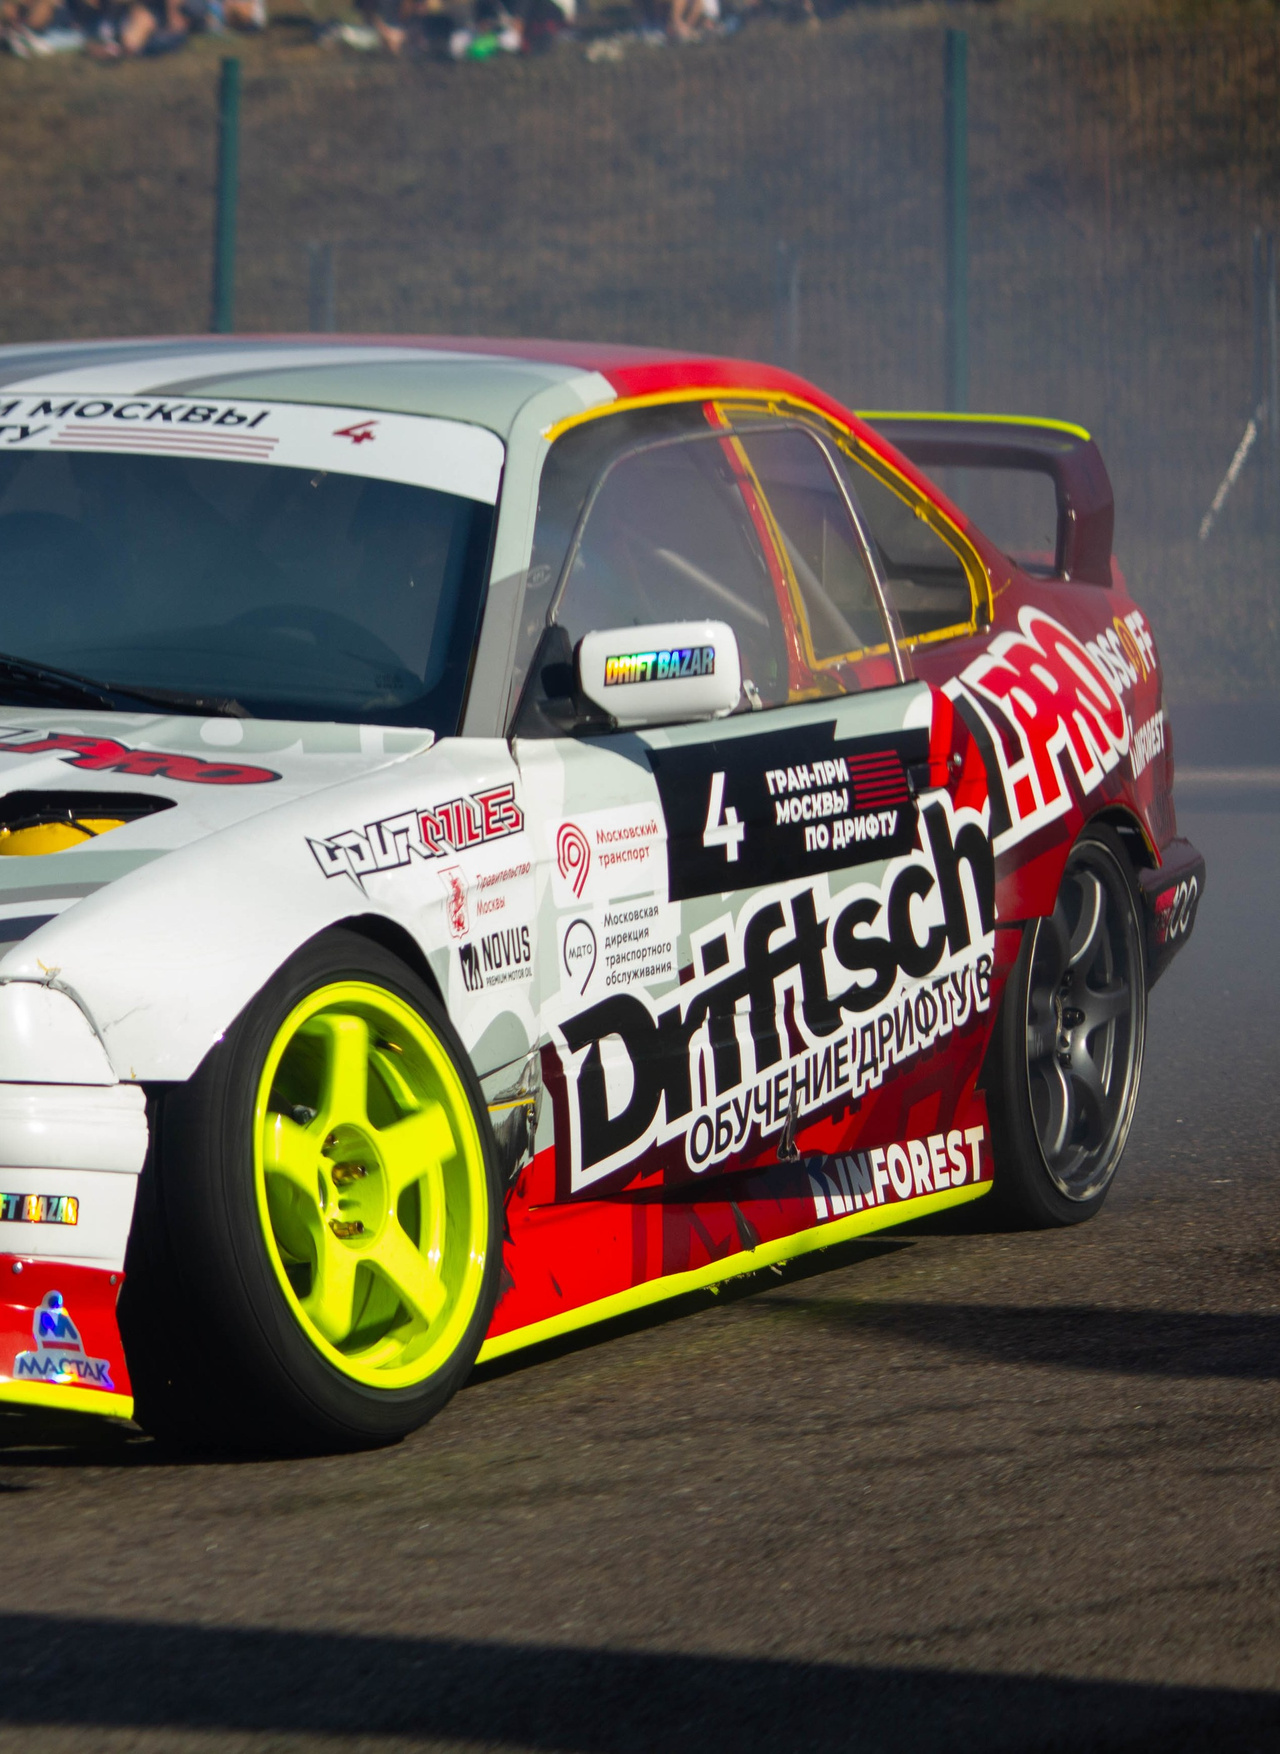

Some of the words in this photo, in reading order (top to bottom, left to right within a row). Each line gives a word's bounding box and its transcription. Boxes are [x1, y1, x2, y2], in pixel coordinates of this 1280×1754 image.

[27, 399, 272, 429] МОСКВЫ
[332, 420, 379, 444] 4
[606, 651, 657, 685] DRIFT
[657, 646, 715, 680] BAZAR
[765, 757, 850, 795] ГРАН-ПРИ
[703, 770, 745, 863] 4
[775, 788, 849, 825] МОСКВЫ
[595, 818, 659, 845] Московский
[804, 826, 829, 851] ПО
[832, 810, 898, 850] ДРИФТУ
[598, 845, 650, 869] транспорт
[476, 861, 531, 891] Правительство
[476, 897, 505, 916] Москвы
[603, 904, 659, 928] Московская
[481, 925, 531, 972] NOVUS
[569, 945, 593, 960] МДТО
[604, 927, 650, 948] дирекция
[605, 942, 672, 967] транспортного
[486, 975, 508, 986] PREMIUM
[508, 970, 523, 982] MOTOR
[524, 968, 533, 977] OIL
[606, 962, 672, 987] обслуживания
[689, 1037, 850, 1164] ОБУЧЕНИЕ
[856, 964, 970, 1085] ДРИФТУ
[805, 1124, 985, 1220] KINFOREST
[22, 1194, 78, 1225] BAZAR
